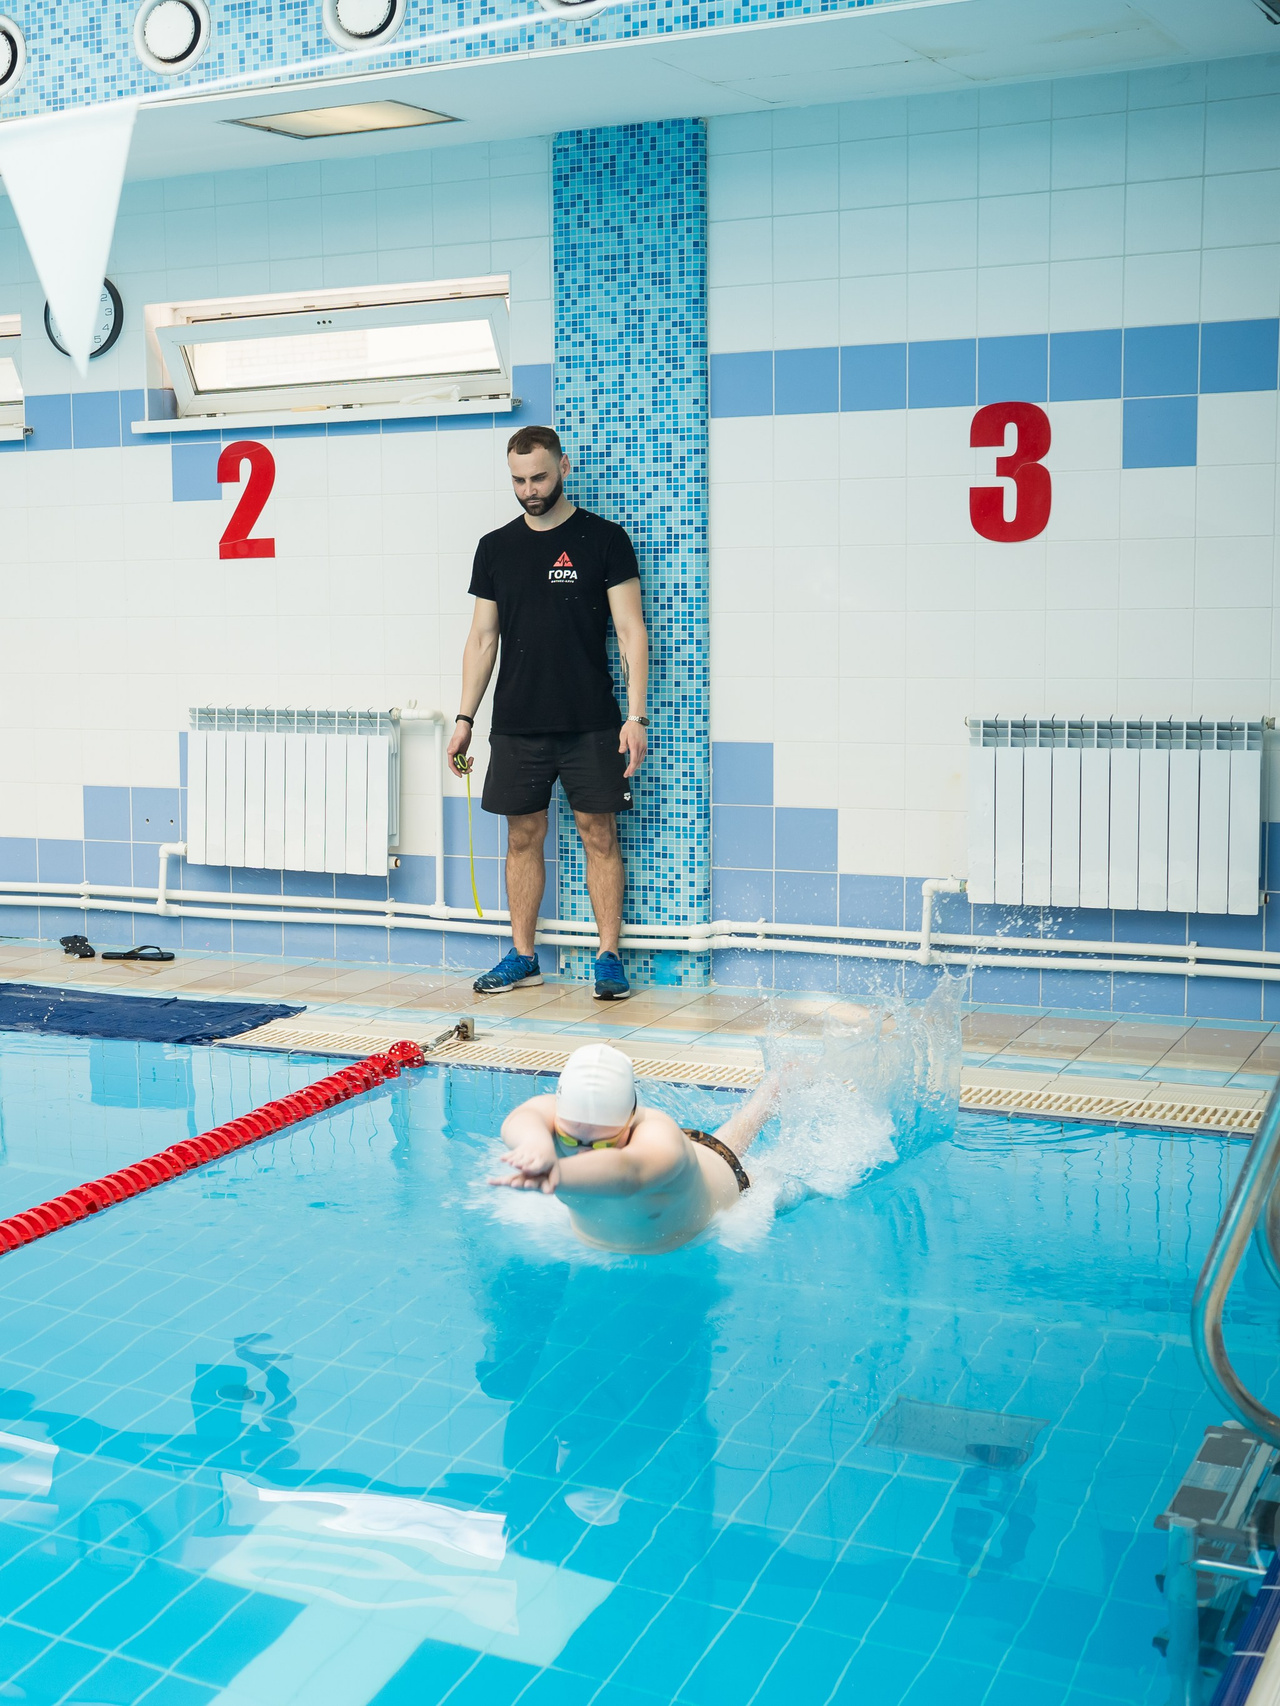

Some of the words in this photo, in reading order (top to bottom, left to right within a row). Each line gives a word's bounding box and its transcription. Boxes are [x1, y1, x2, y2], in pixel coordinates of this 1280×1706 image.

[100, 293, 108, 302] 2
[104, 307, 113, 316] 3
[102, 323, 110, 331] 4
[93, 335, 102, 344] 5
[969, 401, 1052, 543] 3
[216, 440, 276, 560] 2
[548, 569, 578, 580] ГОРА
